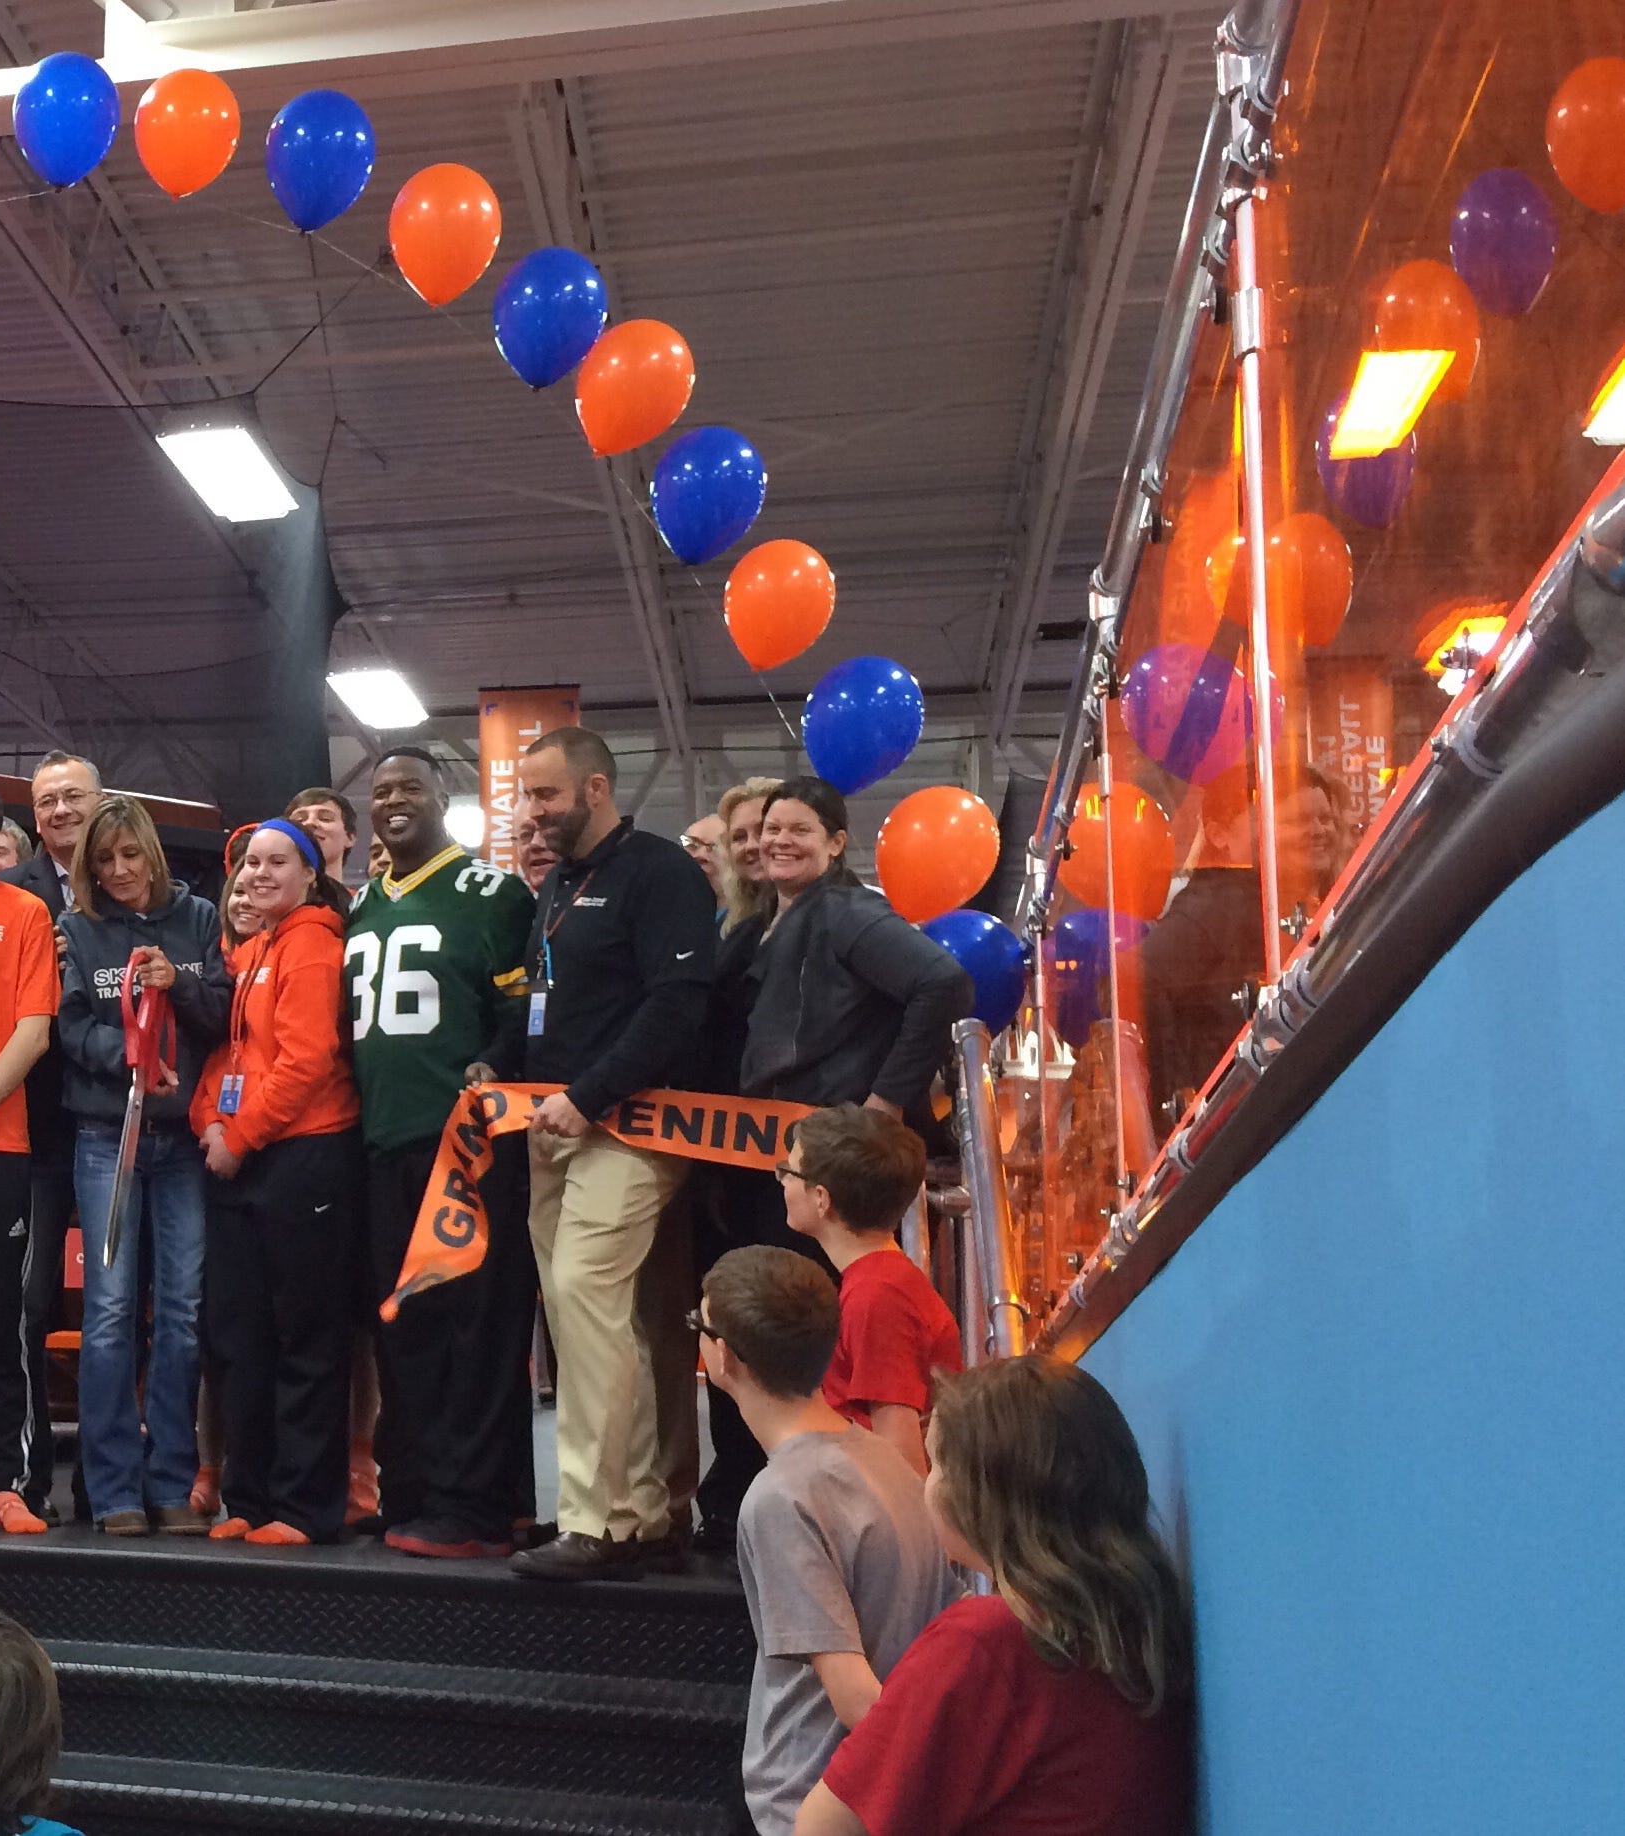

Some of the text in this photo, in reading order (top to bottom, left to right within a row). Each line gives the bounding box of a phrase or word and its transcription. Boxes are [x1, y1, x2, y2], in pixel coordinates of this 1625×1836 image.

[490, 759, 514, 873] TIMATE
[343, 924, 442, 1041] 36
[618, 1100, 799, 1156] ENIN
